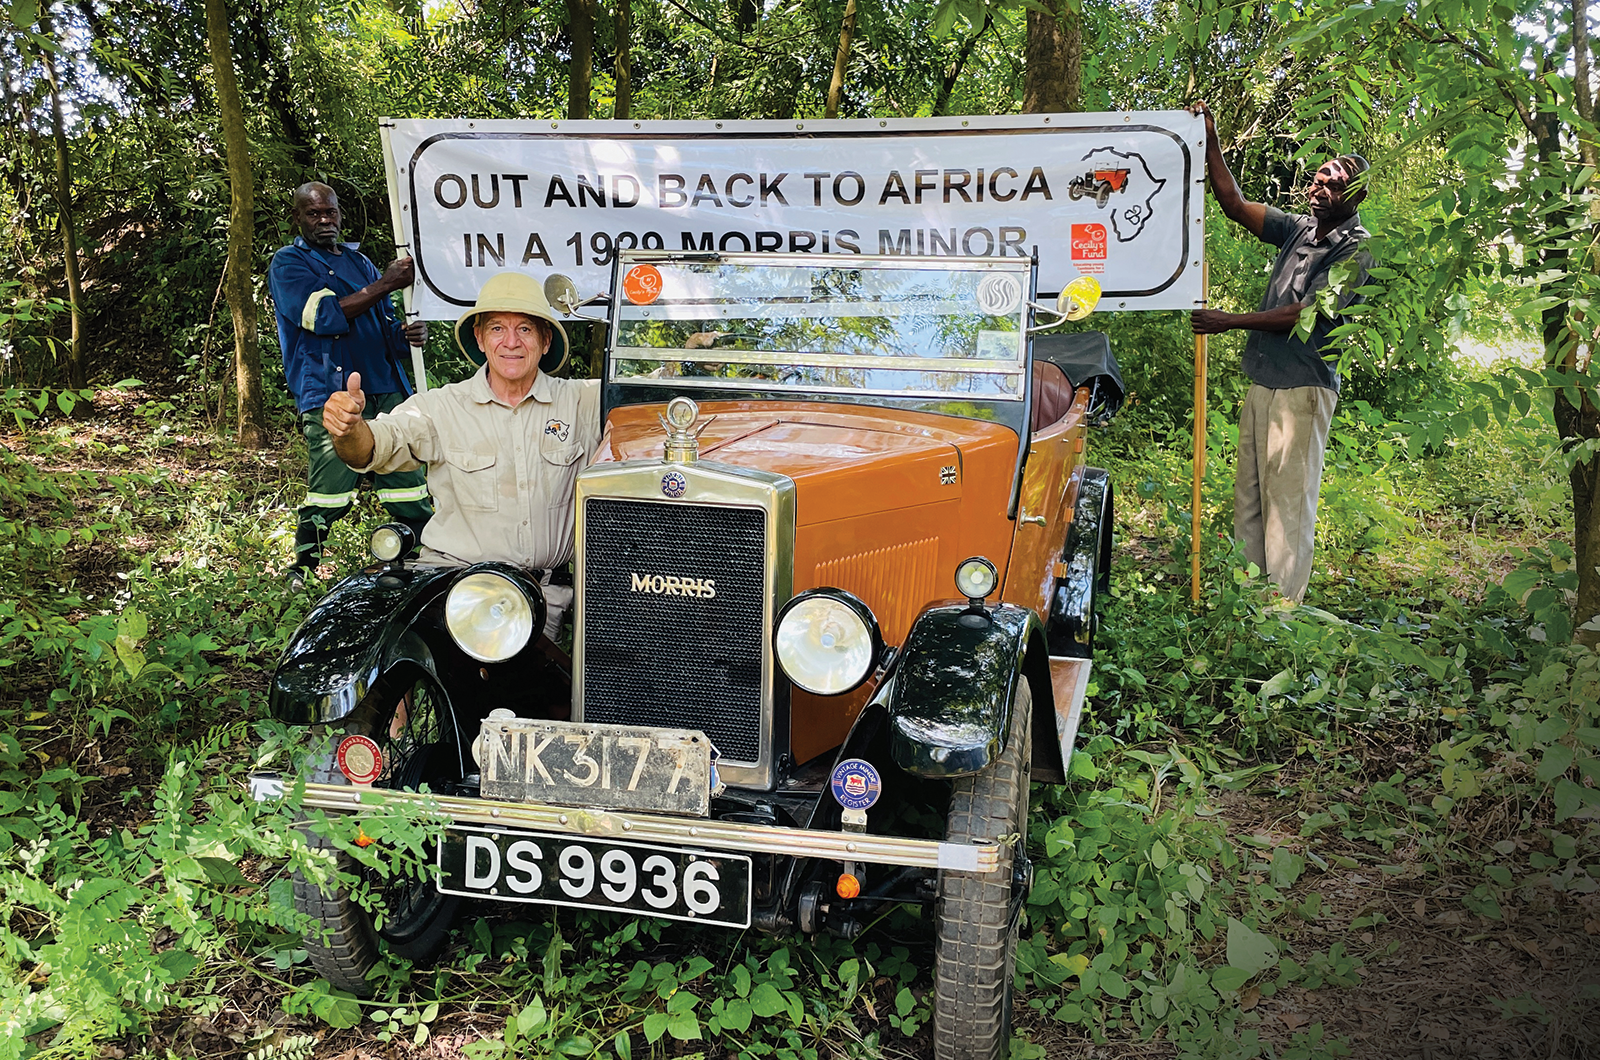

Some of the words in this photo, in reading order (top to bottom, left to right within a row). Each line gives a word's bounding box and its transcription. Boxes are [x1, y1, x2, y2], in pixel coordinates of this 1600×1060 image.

[434, 173, 529, 210] OUT
[544, 174, 641, 208] AND
[658, 172, 791, 209] BACK
[803, 170, 866, 207] TO
[878, 166, 1053, 206] AFRICA
[463, 233, 506, 268] IN
[520, 232, 554, 267] A
[680, 230, 862, 255] MORRIS
[878, 226, 1034, 258] MINOR
[1072, 239, 1104, 251] Cecily's
[1082, 249, 1105, 258] Fund
[630, 573, 716, 599] MORRIS
[836, 763, 858, 779] VINTAGE
[859, 764, 876, 783] MINOR
[840, 794, 871, 808] REGISTER
[465, 835, 544, 895] DS
[558, 844, 721, 915] 9936
